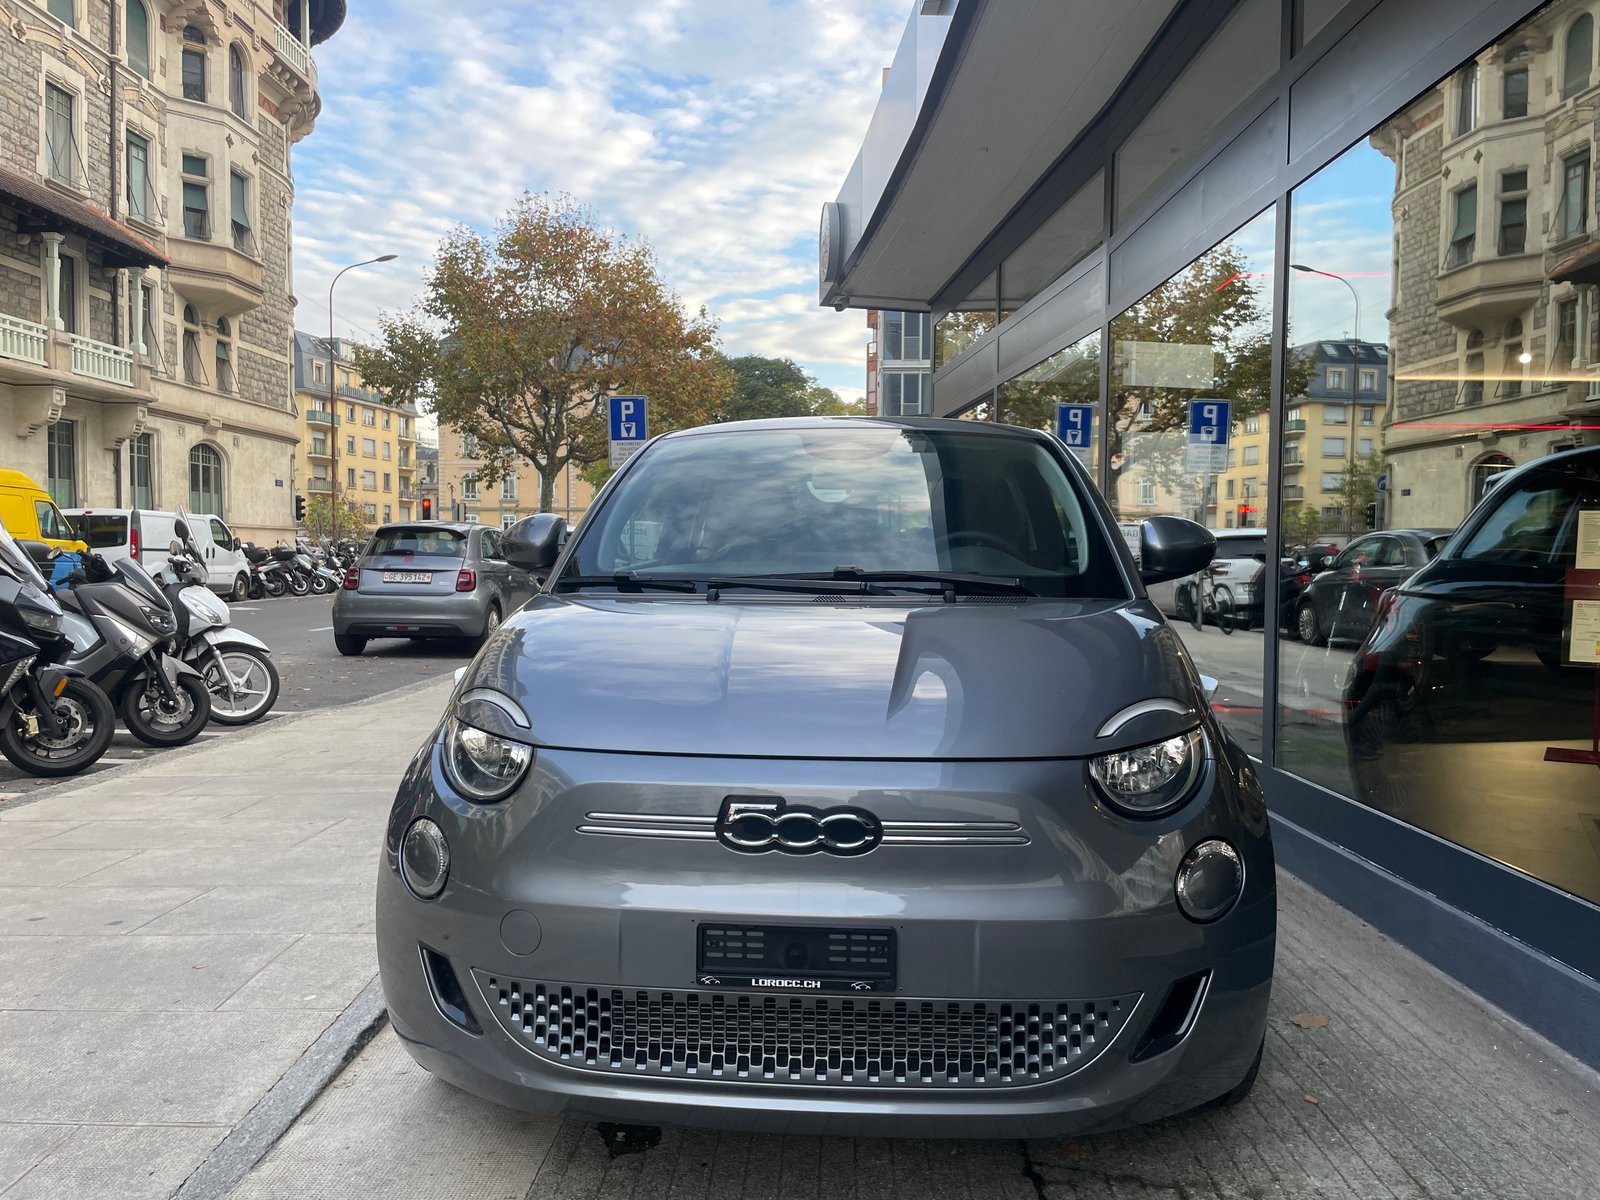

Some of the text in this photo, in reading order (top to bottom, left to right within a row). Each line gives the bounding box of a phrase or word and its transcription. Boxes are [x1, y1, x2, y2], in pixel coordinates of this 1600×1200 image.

[621, 401, 634, 421] P
[722, 801, 876, 849] 500
[751, 978, 821, 989] LOROCC.CH
